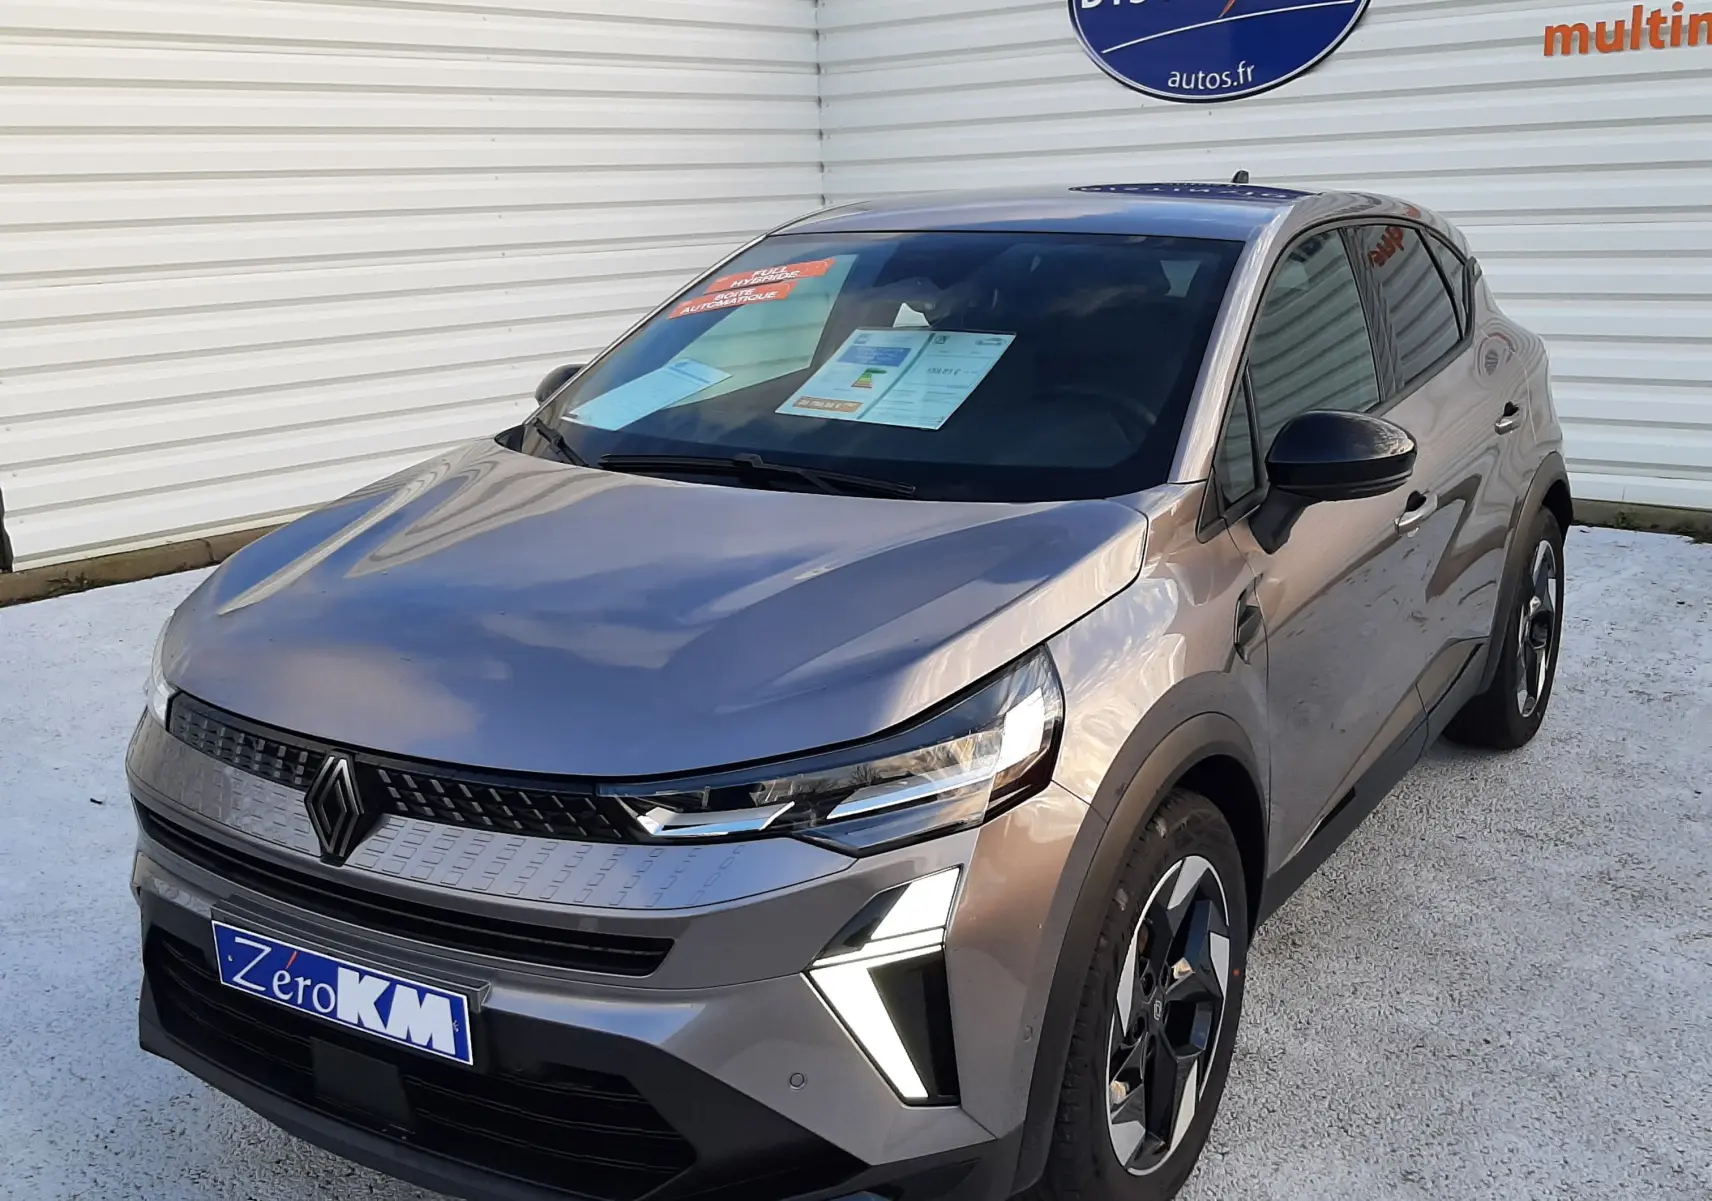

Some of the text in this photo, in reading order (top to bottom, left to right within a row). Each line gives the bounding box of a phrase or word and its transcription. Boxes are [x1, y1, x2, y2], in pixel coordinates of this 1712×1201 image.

[1167, 61, 1255, 90] autos.fr
[730, 270, 801, 288] HYBRIDE
[752, 266, 789, 279] FULL
[679, 291, 778, 315] AUTOMATIQUE
